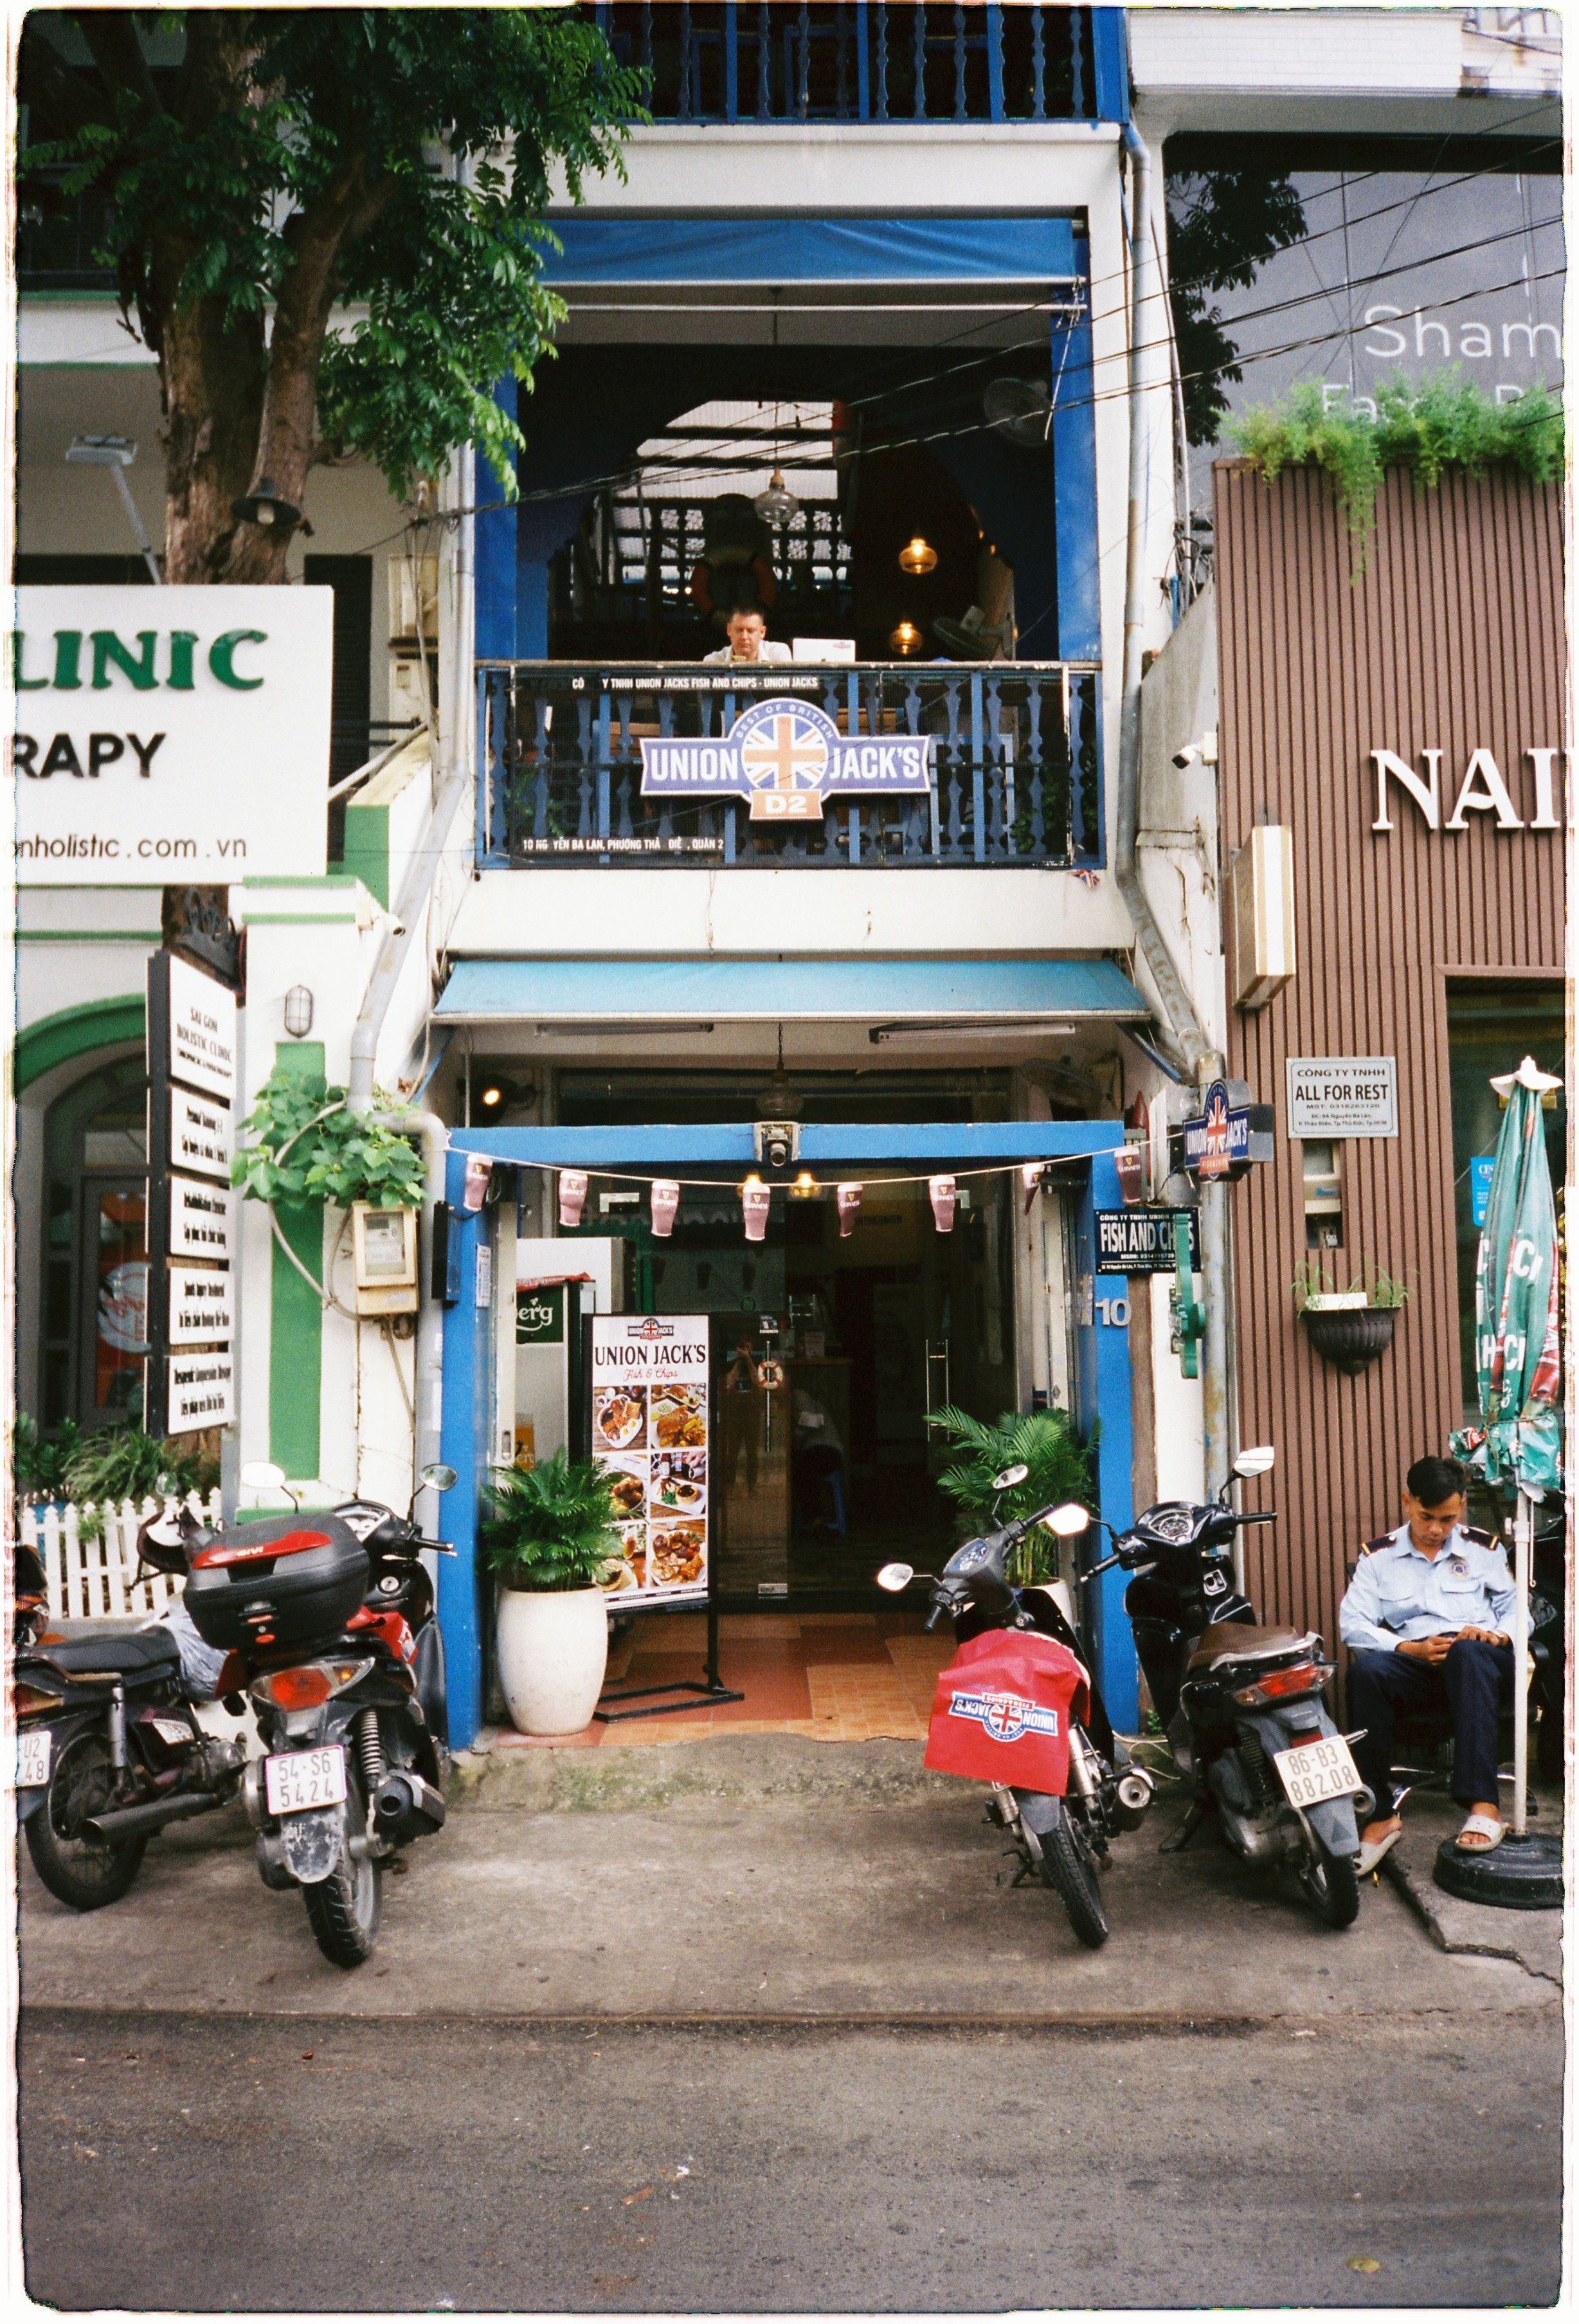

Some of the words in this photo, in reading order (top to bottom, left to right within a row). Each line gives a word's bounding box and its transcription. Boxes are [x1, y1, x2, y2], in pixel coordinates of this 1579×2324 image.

[610, 678, 633, 689] TNHH
[635, 678, 662, 689] UNION
[663, 678, 690, 689] JACKS
[691, 678, 710, 689] FISH
[712, 678, 730, 688] AND
[732, 677, 757, 688] CHIPS
[763, 677, 790, 688] UNION
[791, 677, 818, 688] JACKS
[735, 705, 767, 739] BEST
[766, 704, 782, 714] OF
[789, 704, 835, 740] BRITISH
[650, 747, 738, 781] UNION
[829, 746, 920, 780] JACK'S
[765, 794, 808, 814] D2
[1297, 1068, 1332, 1077] CÔNG
[1295, 1085, 1321, 1101] ALL
[1324, 1084, 1352, 1100] FOR
[1355, 1084, 1389, 1100] REST
[1187, 1127, 1207, 1155] UNION
[1225, 1118, 1248, 1148] JACK'S
[1100, 1222, 1127, 1253] FISH
[1128, 1222, 1157, 1251] AND
[1159, 1221, 1195, 1251] CHS
[516, 1305, 554, 1327] erg
[1096, 1297, 1132, 1327] 10
[595, 1345, 647, 1366] UNION
[653, 1344, 706, 1365] JACK'S
[623, 1368, 643, 1382] Fish
[645, 1368, 653, 1377] &
[655, 1368, 679, 1379] Chips
[955, 1698, 992, 1718] JACK'S
[1022, 1710, 1054, 1730] UNION
[279, 1780, 334, 1808] 5424
[1290, 1765, 1355, 1802] 882.08
